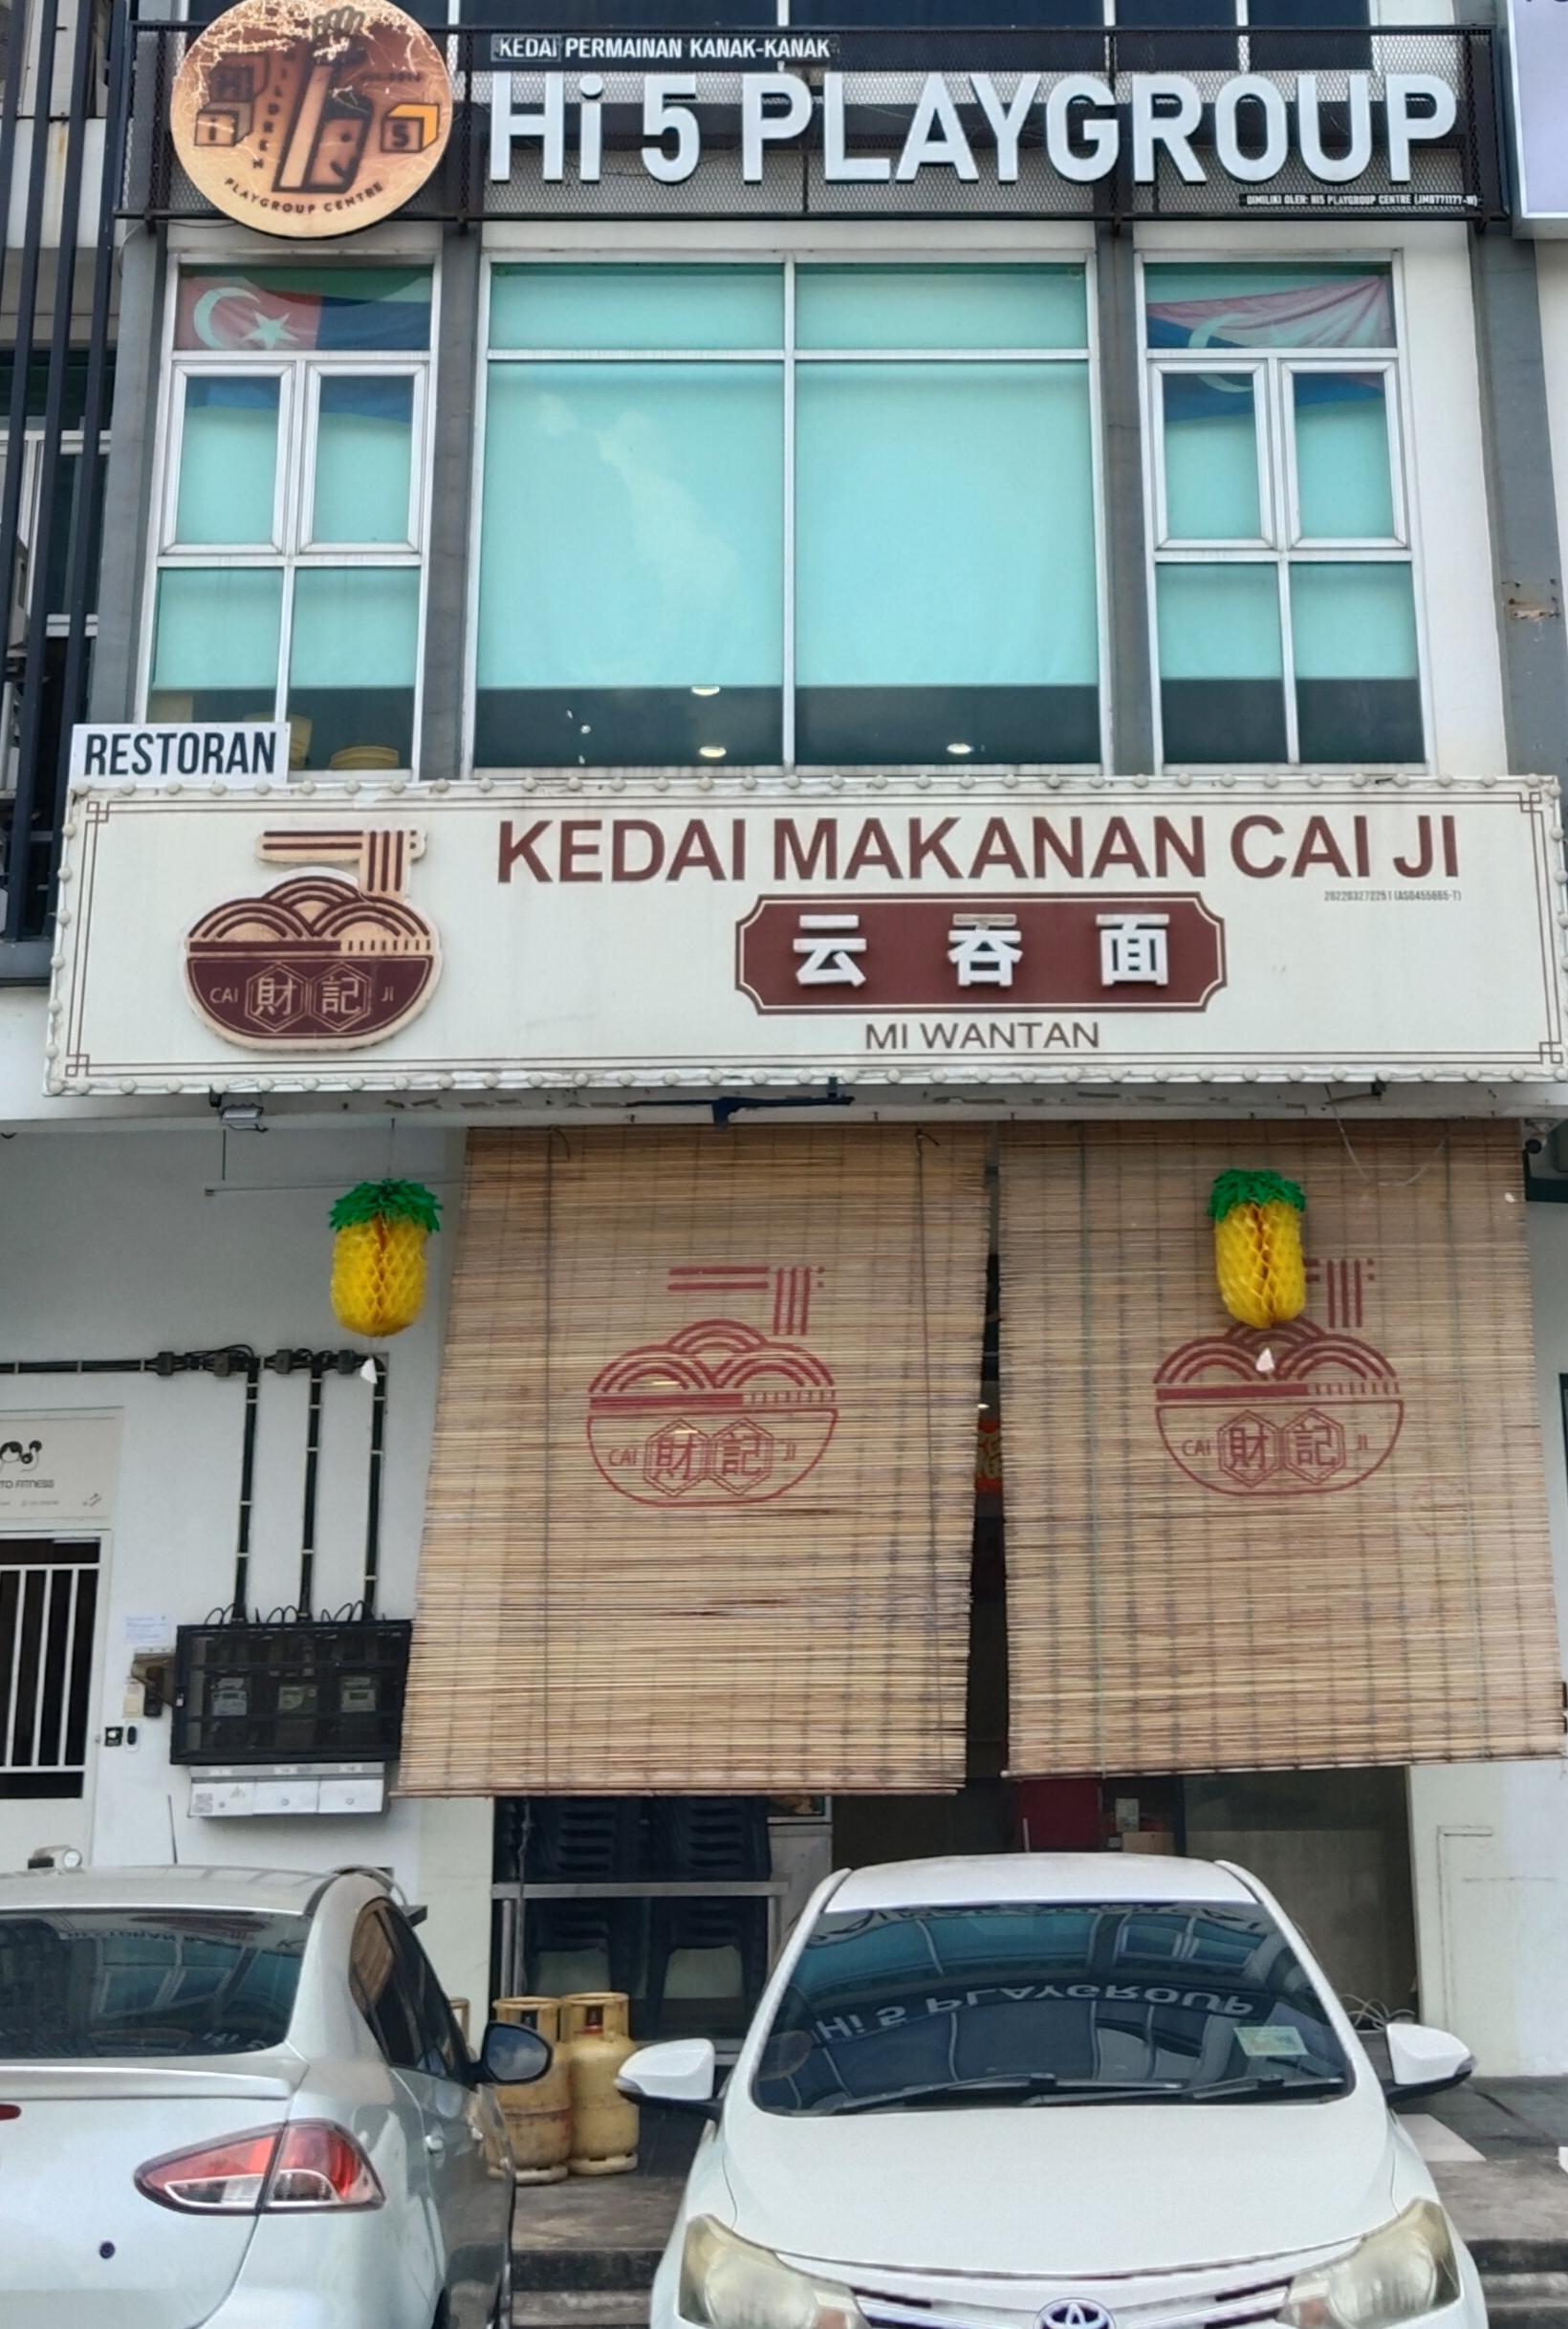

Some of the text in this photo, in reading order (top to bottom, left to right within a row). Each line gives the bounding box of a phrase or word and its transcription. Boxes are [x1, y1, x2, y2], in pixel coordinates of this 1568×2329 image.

[498, 36, 831, 59] KEDAI PERMAINAN KANAK-KANAK
[489, 72, 1457, 185] Hi 5 PLAYGROUP
[224, 177, 385, 214] PLAYGROUP CENTRE
[1246, 194, 1282, 206] DIMILIKI
[1327, 194, 1376, 206] PLAYGROUP
[1379, 193, 1411, 205] CENTRE
[83, 730, 277, 776] RESTORAN
[496, 814, 1459, 883] KEDAI MAKANAN CAI JI
[792, 912, 1171, 989] 云吞面
[209, 987, 239, 1004] CAI
[255, 975, 362, 1016] 財記
[381, 986, 395, 1002] JI
[864, 1021, 1100, 1050] MI WANTAN
[607, 1447, 637, 1468] CAI
[651, 1431, 763, 1481] 財記
[1181, 1438, 1211, 1457] CAI
[1228, 1423, 1339, 1470] 財記
